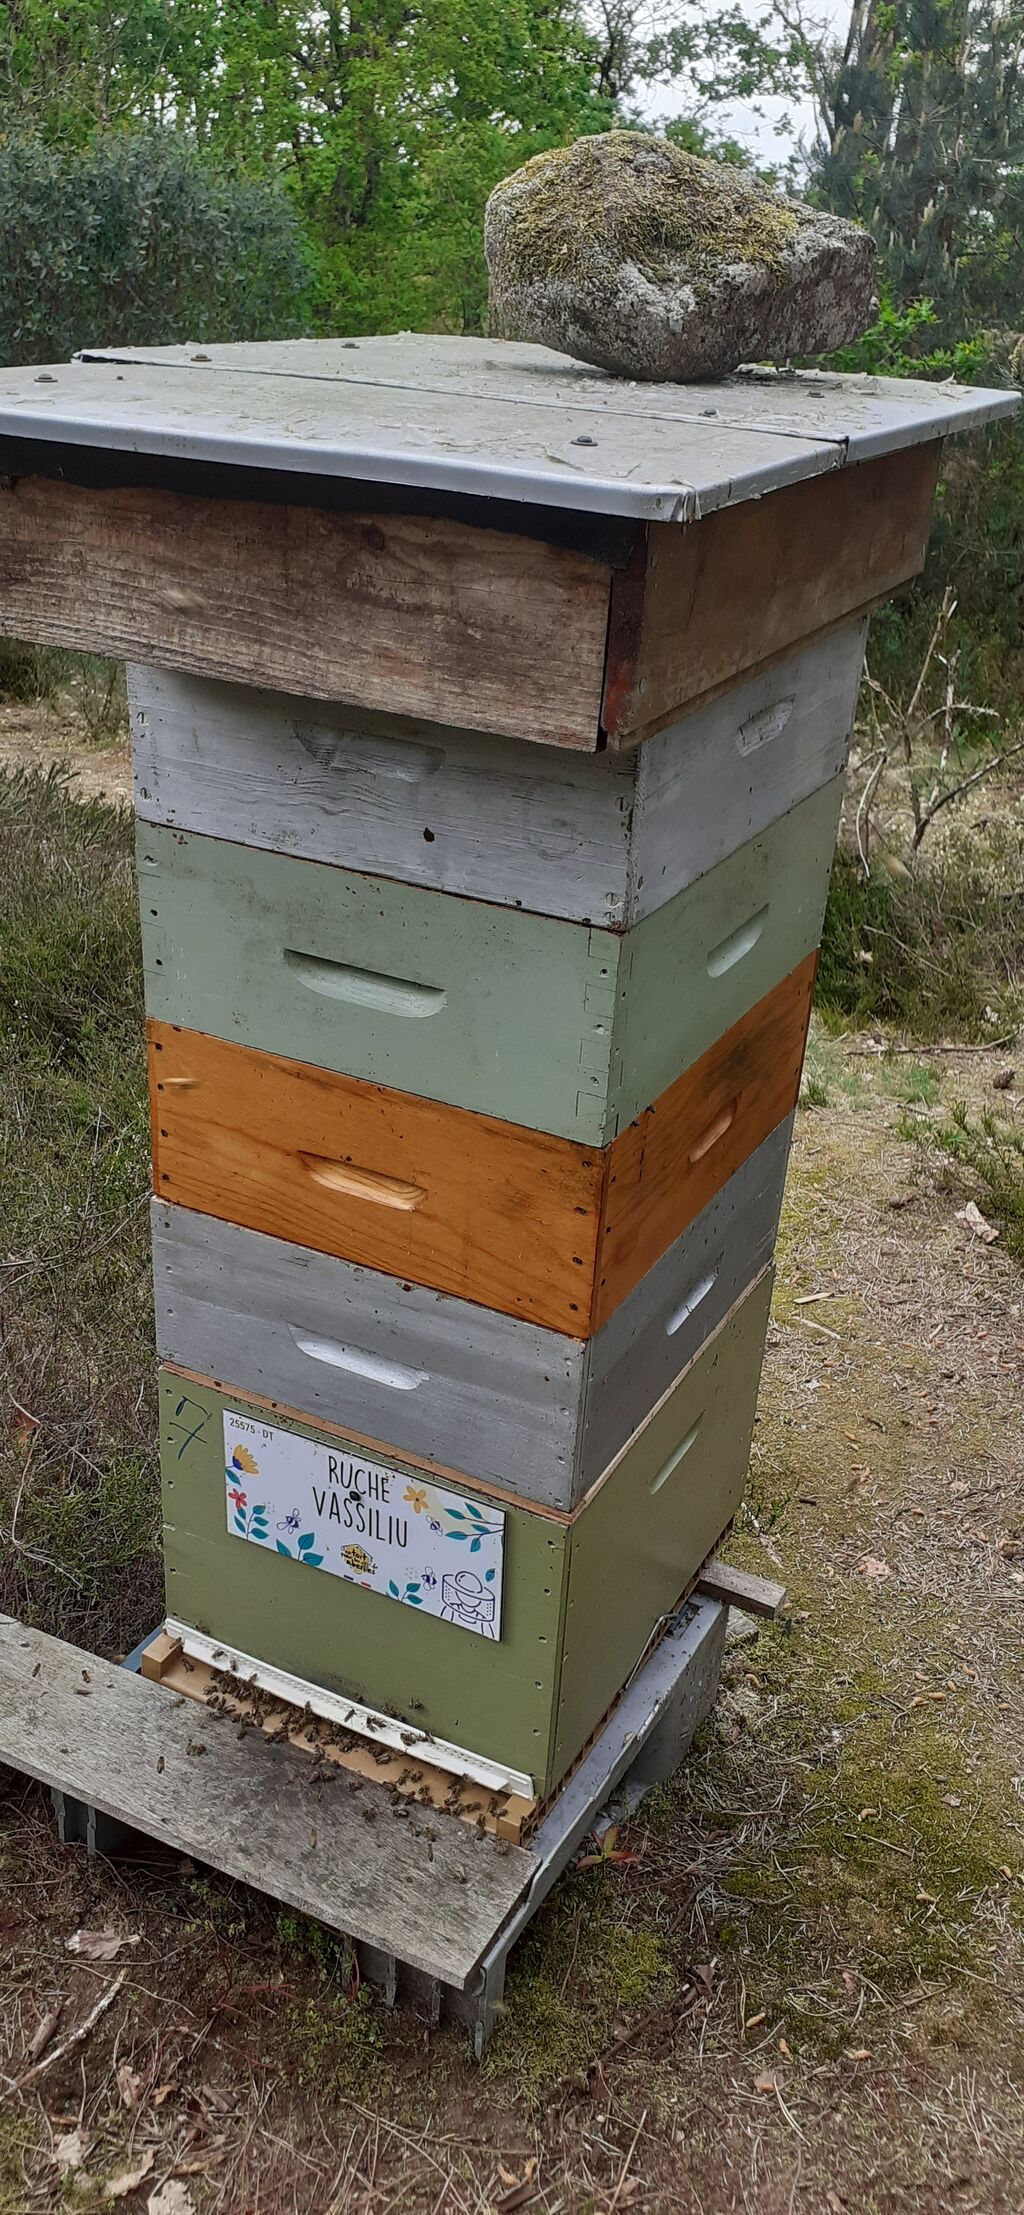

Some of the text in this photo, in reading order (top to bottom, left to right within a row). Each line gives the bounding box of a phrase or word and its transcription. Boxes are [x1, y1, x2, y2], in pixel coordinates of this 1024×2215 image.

[230, 1417, 256, 1434] 25575
[262, 1429, 274, 1441] DT
[328, 1455, 390, 1504] RUCHE
[312, 1486, 408, 1548] VASSILIU
